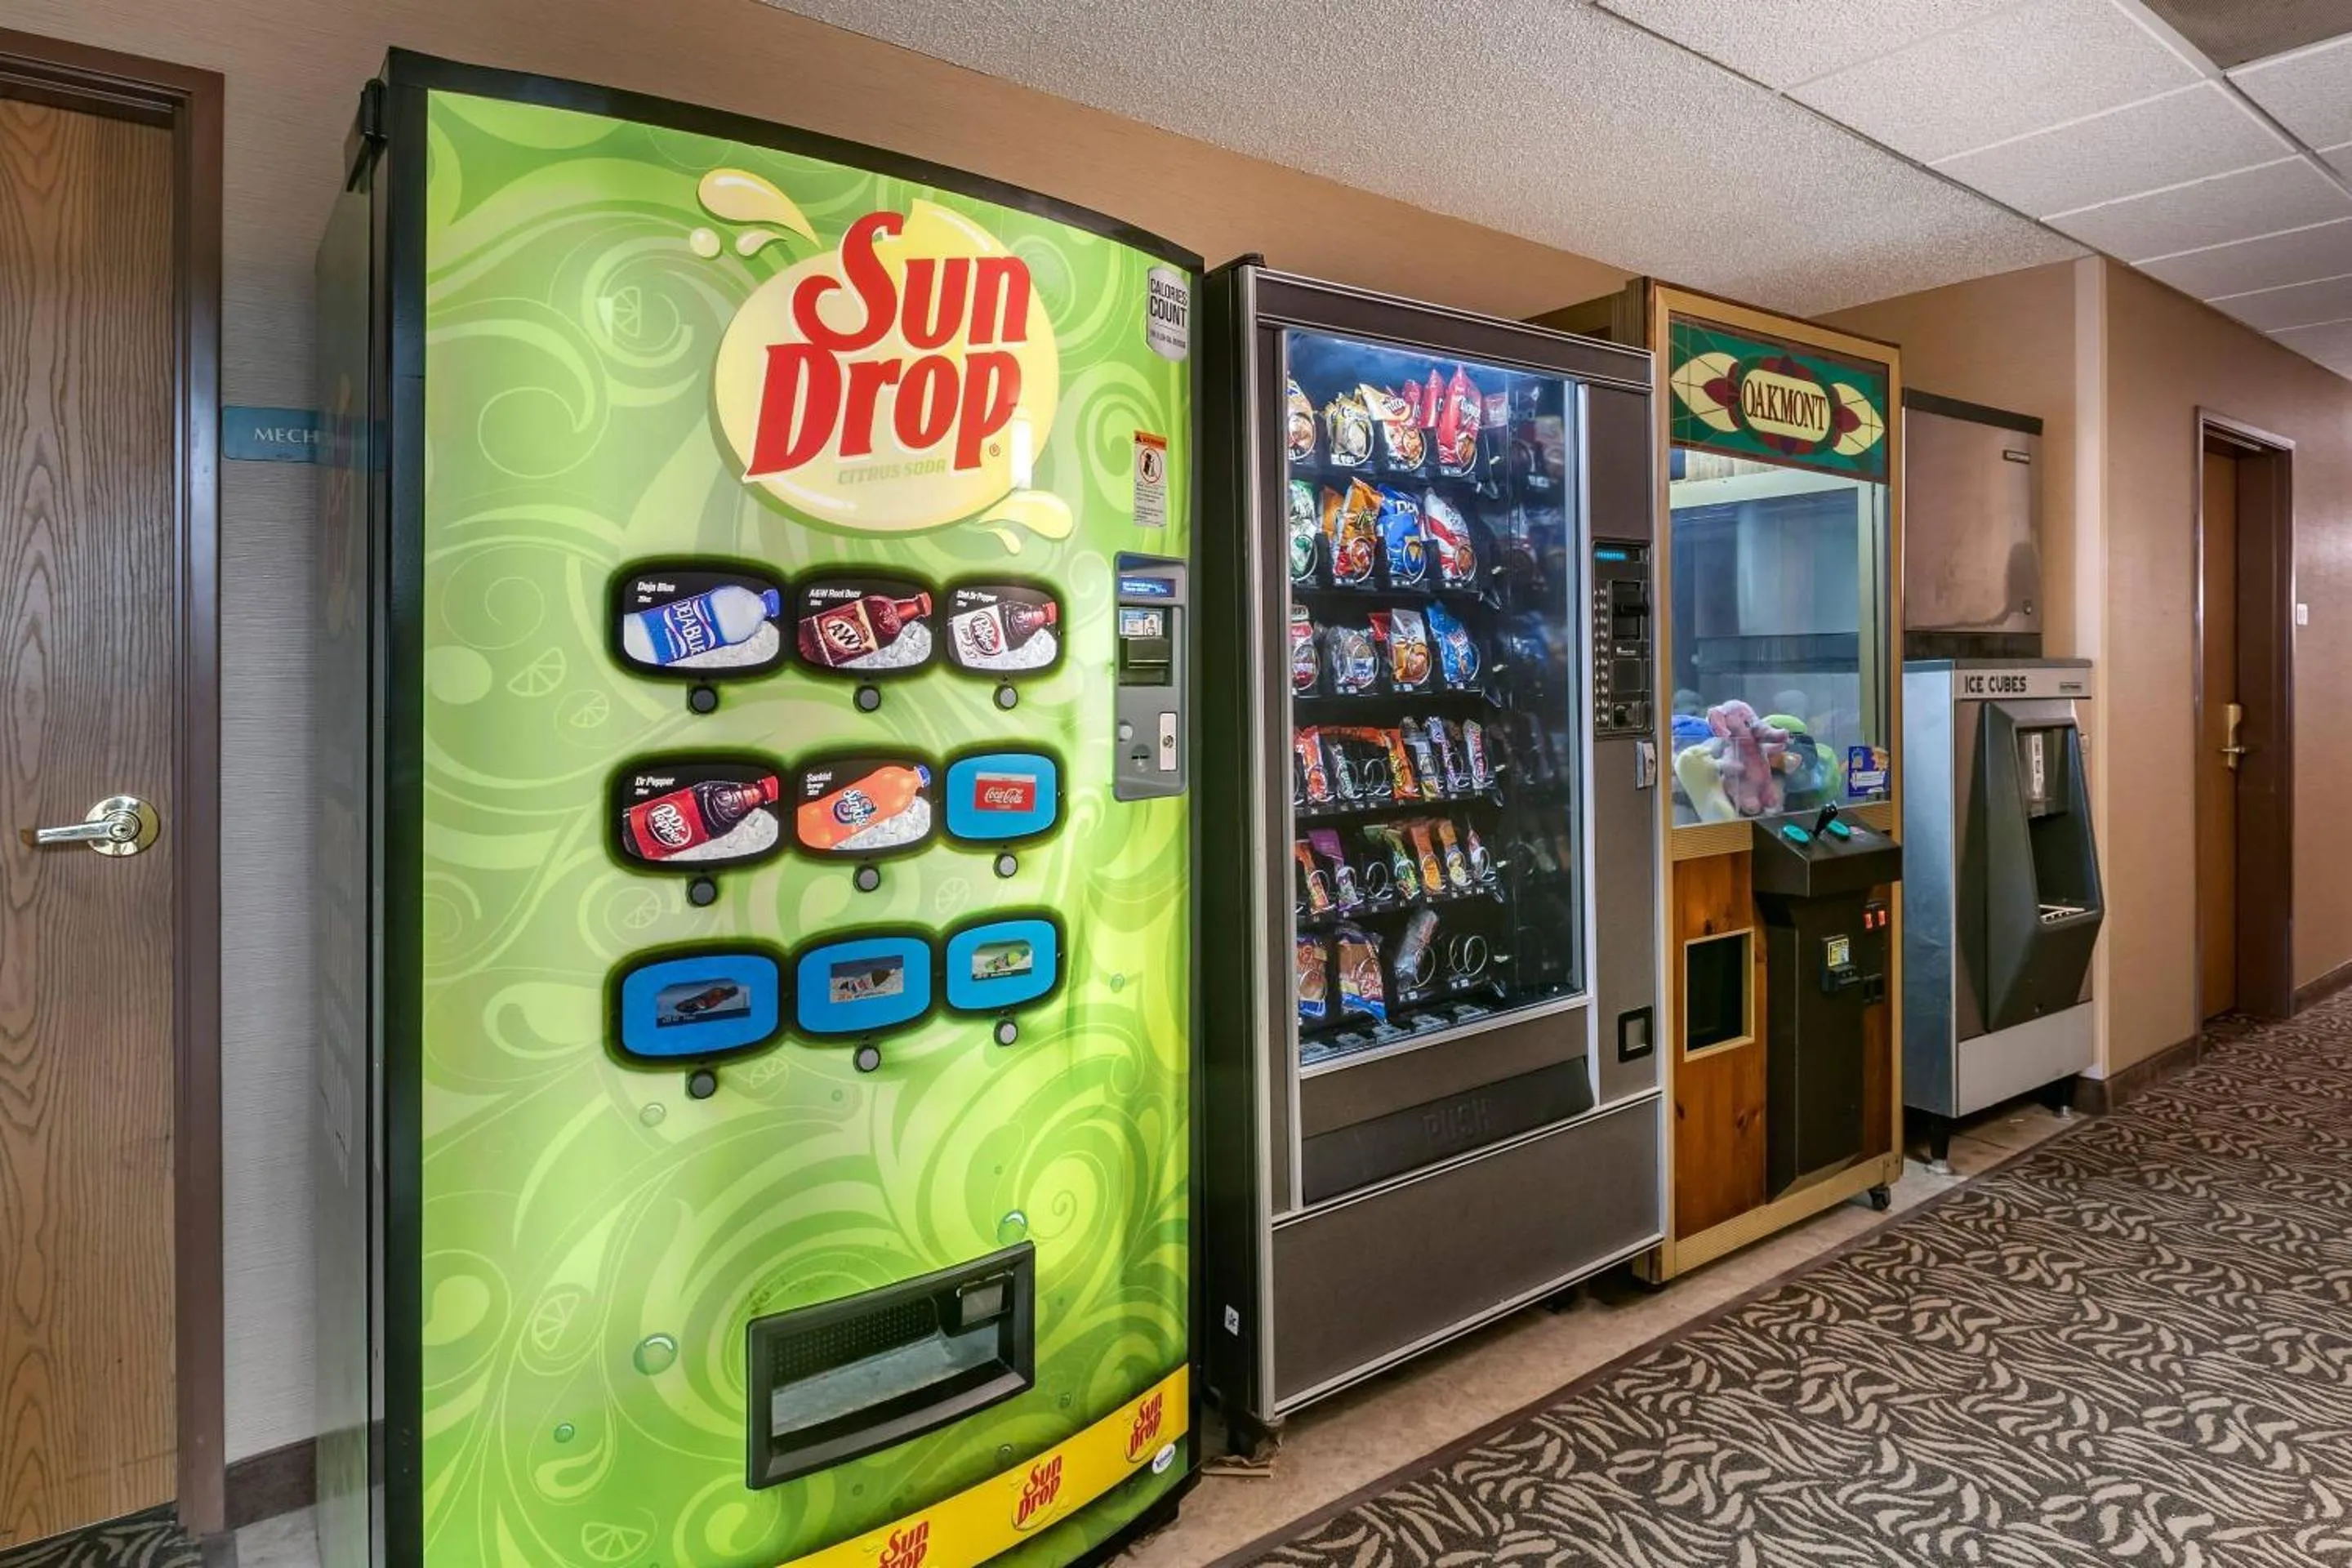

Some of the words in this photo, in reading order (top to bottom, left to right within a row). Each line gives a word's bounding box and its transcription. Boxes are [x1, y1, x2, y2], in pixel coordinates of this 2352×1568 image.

[792, 211, 1031, 352] Sun
[1150, 278, 1187, 306] CALORIES
[1150, 296, 1187, 327] COUNT
[746, 343, 1022, 476] Drop
[1743, 378, 1826, 431] OAKMONT
[837, 463, 901, 484] CITRUS
[904, 458, 947, 475] SODA
[657, 582, 675, 592] Blue
[1964, 676, 1984, 693] ICE
[1989, 675, 2027, 693] CUBES
[635, 777, 645, 786] Dr
[646, 777, 675, 788] Pepper
[1133, 1392, 1163, 1431] Sun
[1023, 1454, 1062, 1498] Sun
[1018, 1476, 1061, 1526] Drop
[879, 1520, 929, 1564] Sun
